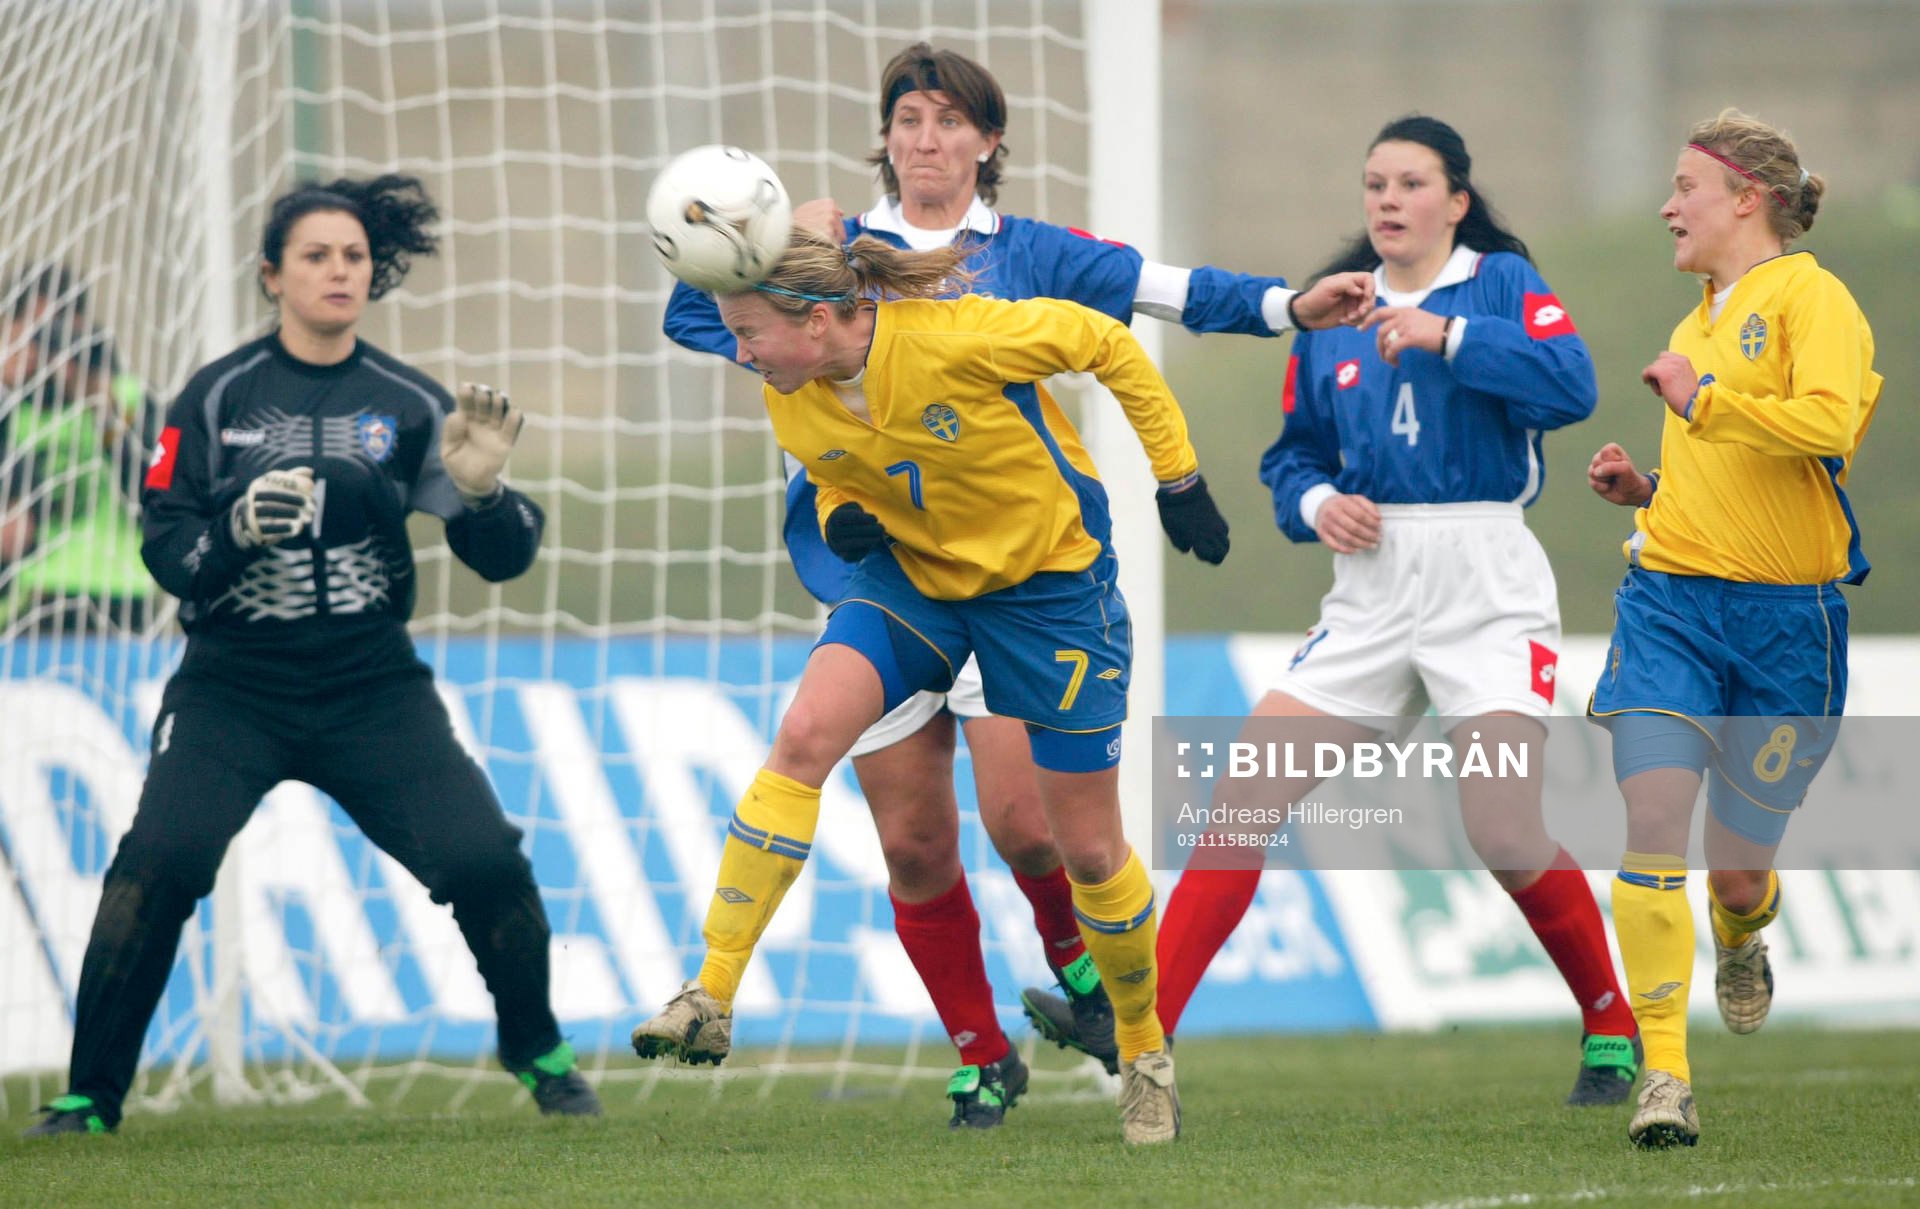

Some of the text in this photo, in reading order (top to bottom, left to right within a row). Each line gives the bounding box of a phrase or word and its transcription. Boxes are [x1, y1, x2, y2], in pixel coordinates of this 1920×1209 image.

[1391, 382, 1420, 447] 4
[884, 460, 925, 512] 7
[1055, 649, 1089, 711] 7
[1753, 724, 1797, 783] 8
